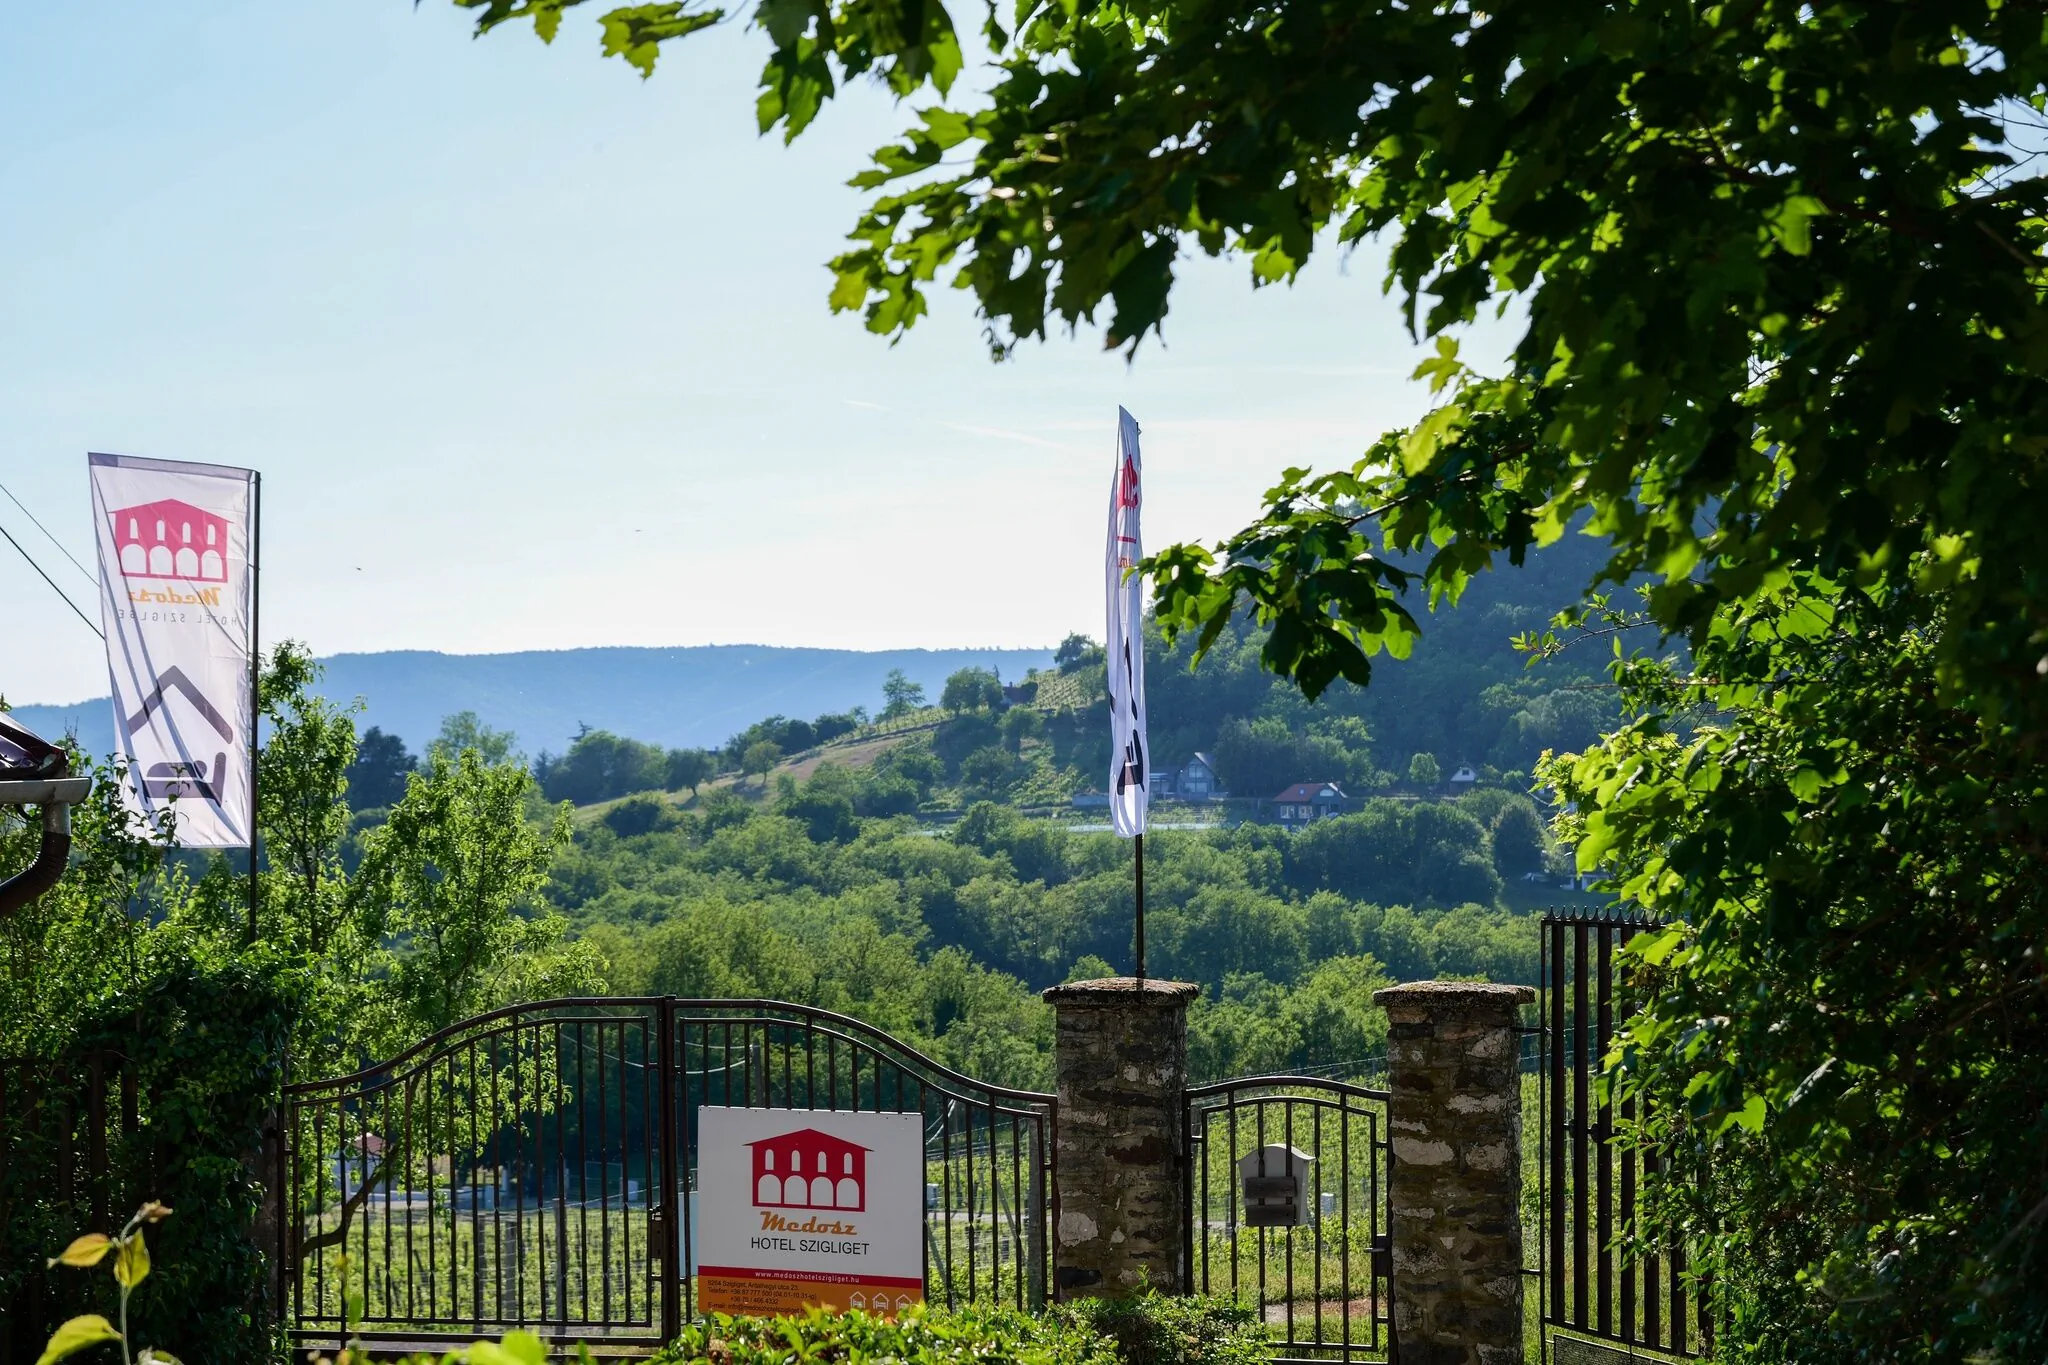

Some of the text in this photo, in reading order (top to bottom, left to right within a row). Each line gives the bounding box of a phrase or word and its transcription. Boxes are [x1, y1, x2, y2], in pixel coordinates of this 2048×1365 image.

[760, 1211, 857, 1235] Medosz
[751, 1237, 869, 1255] HOTEL SZIGLIGET
[755, 1271, 860, 1284] www.medoszhotelszigliget.hu
